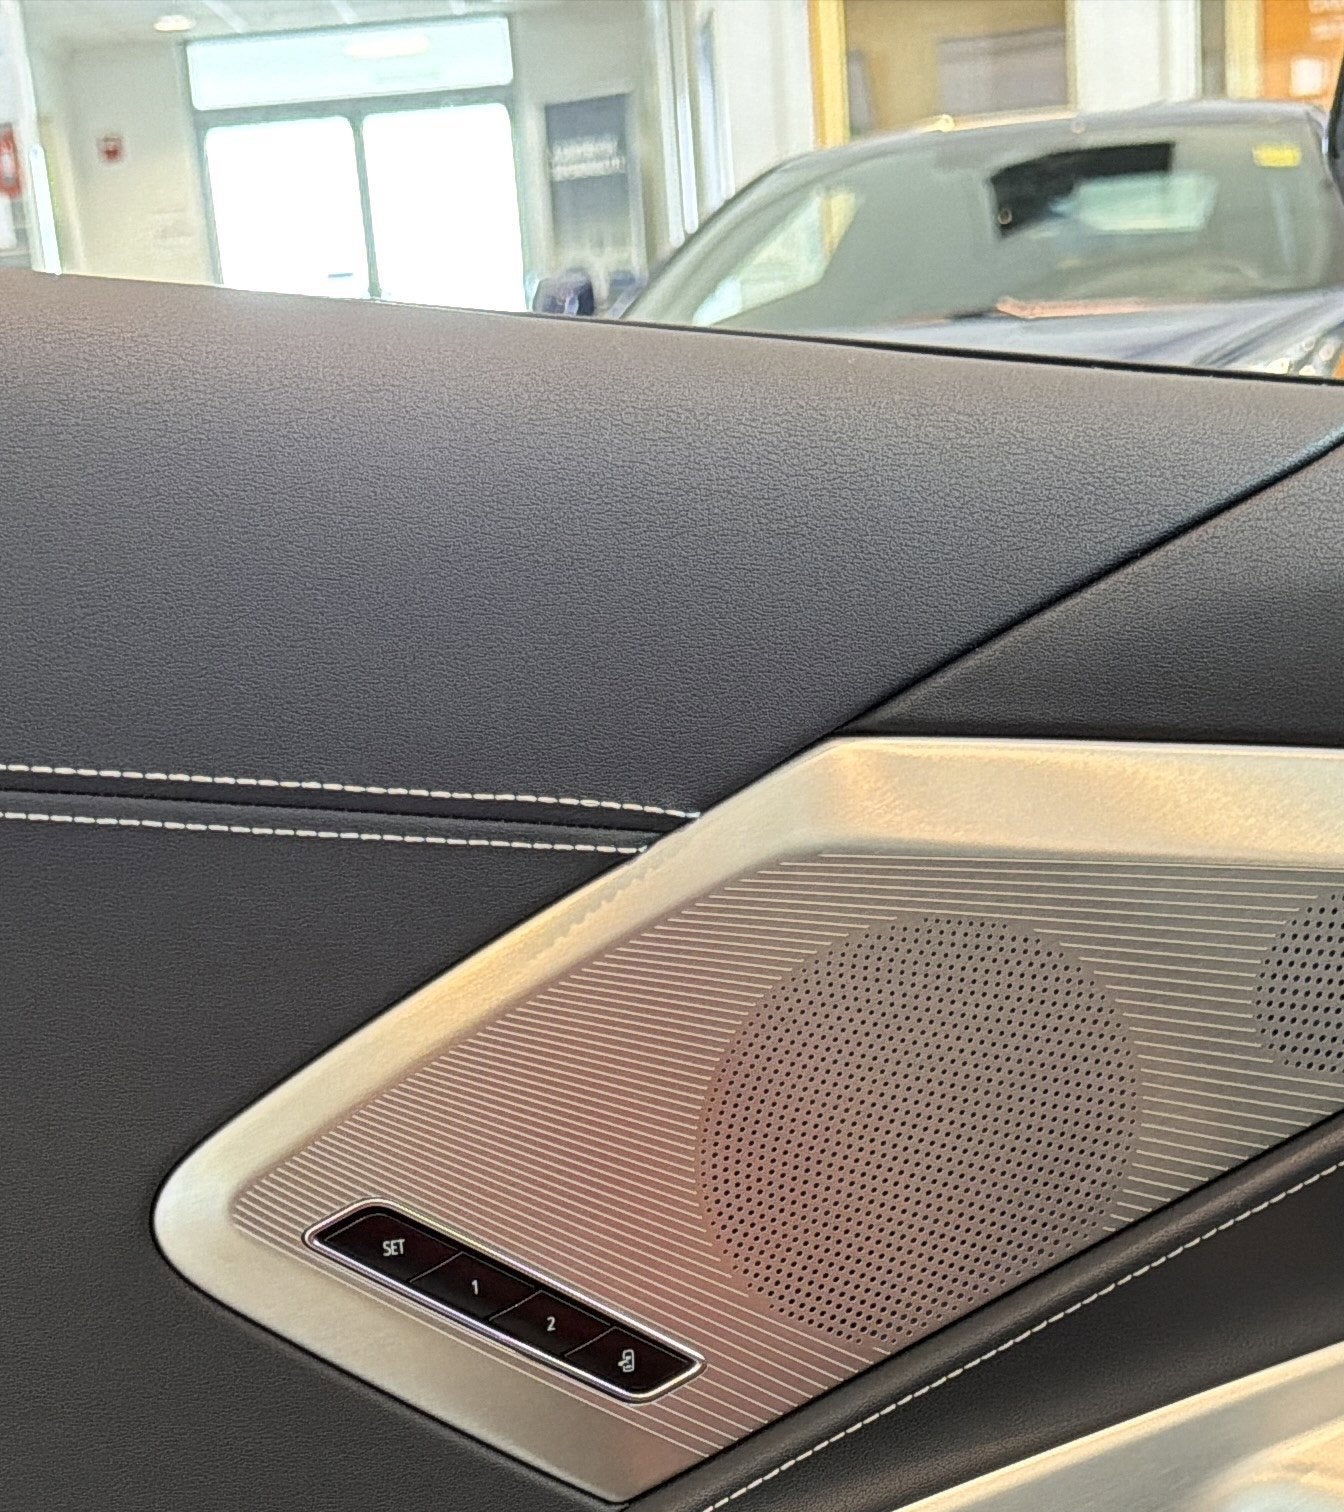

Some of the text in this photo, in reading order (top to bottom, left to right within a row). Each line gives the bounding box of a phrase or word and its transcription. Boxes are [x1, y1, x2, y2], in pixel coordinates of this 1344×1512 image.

[382, 1239, 405, 1257] SET
[471, 1279, 479, 1296] 1
[546, 1316, 556, 1332] 2
